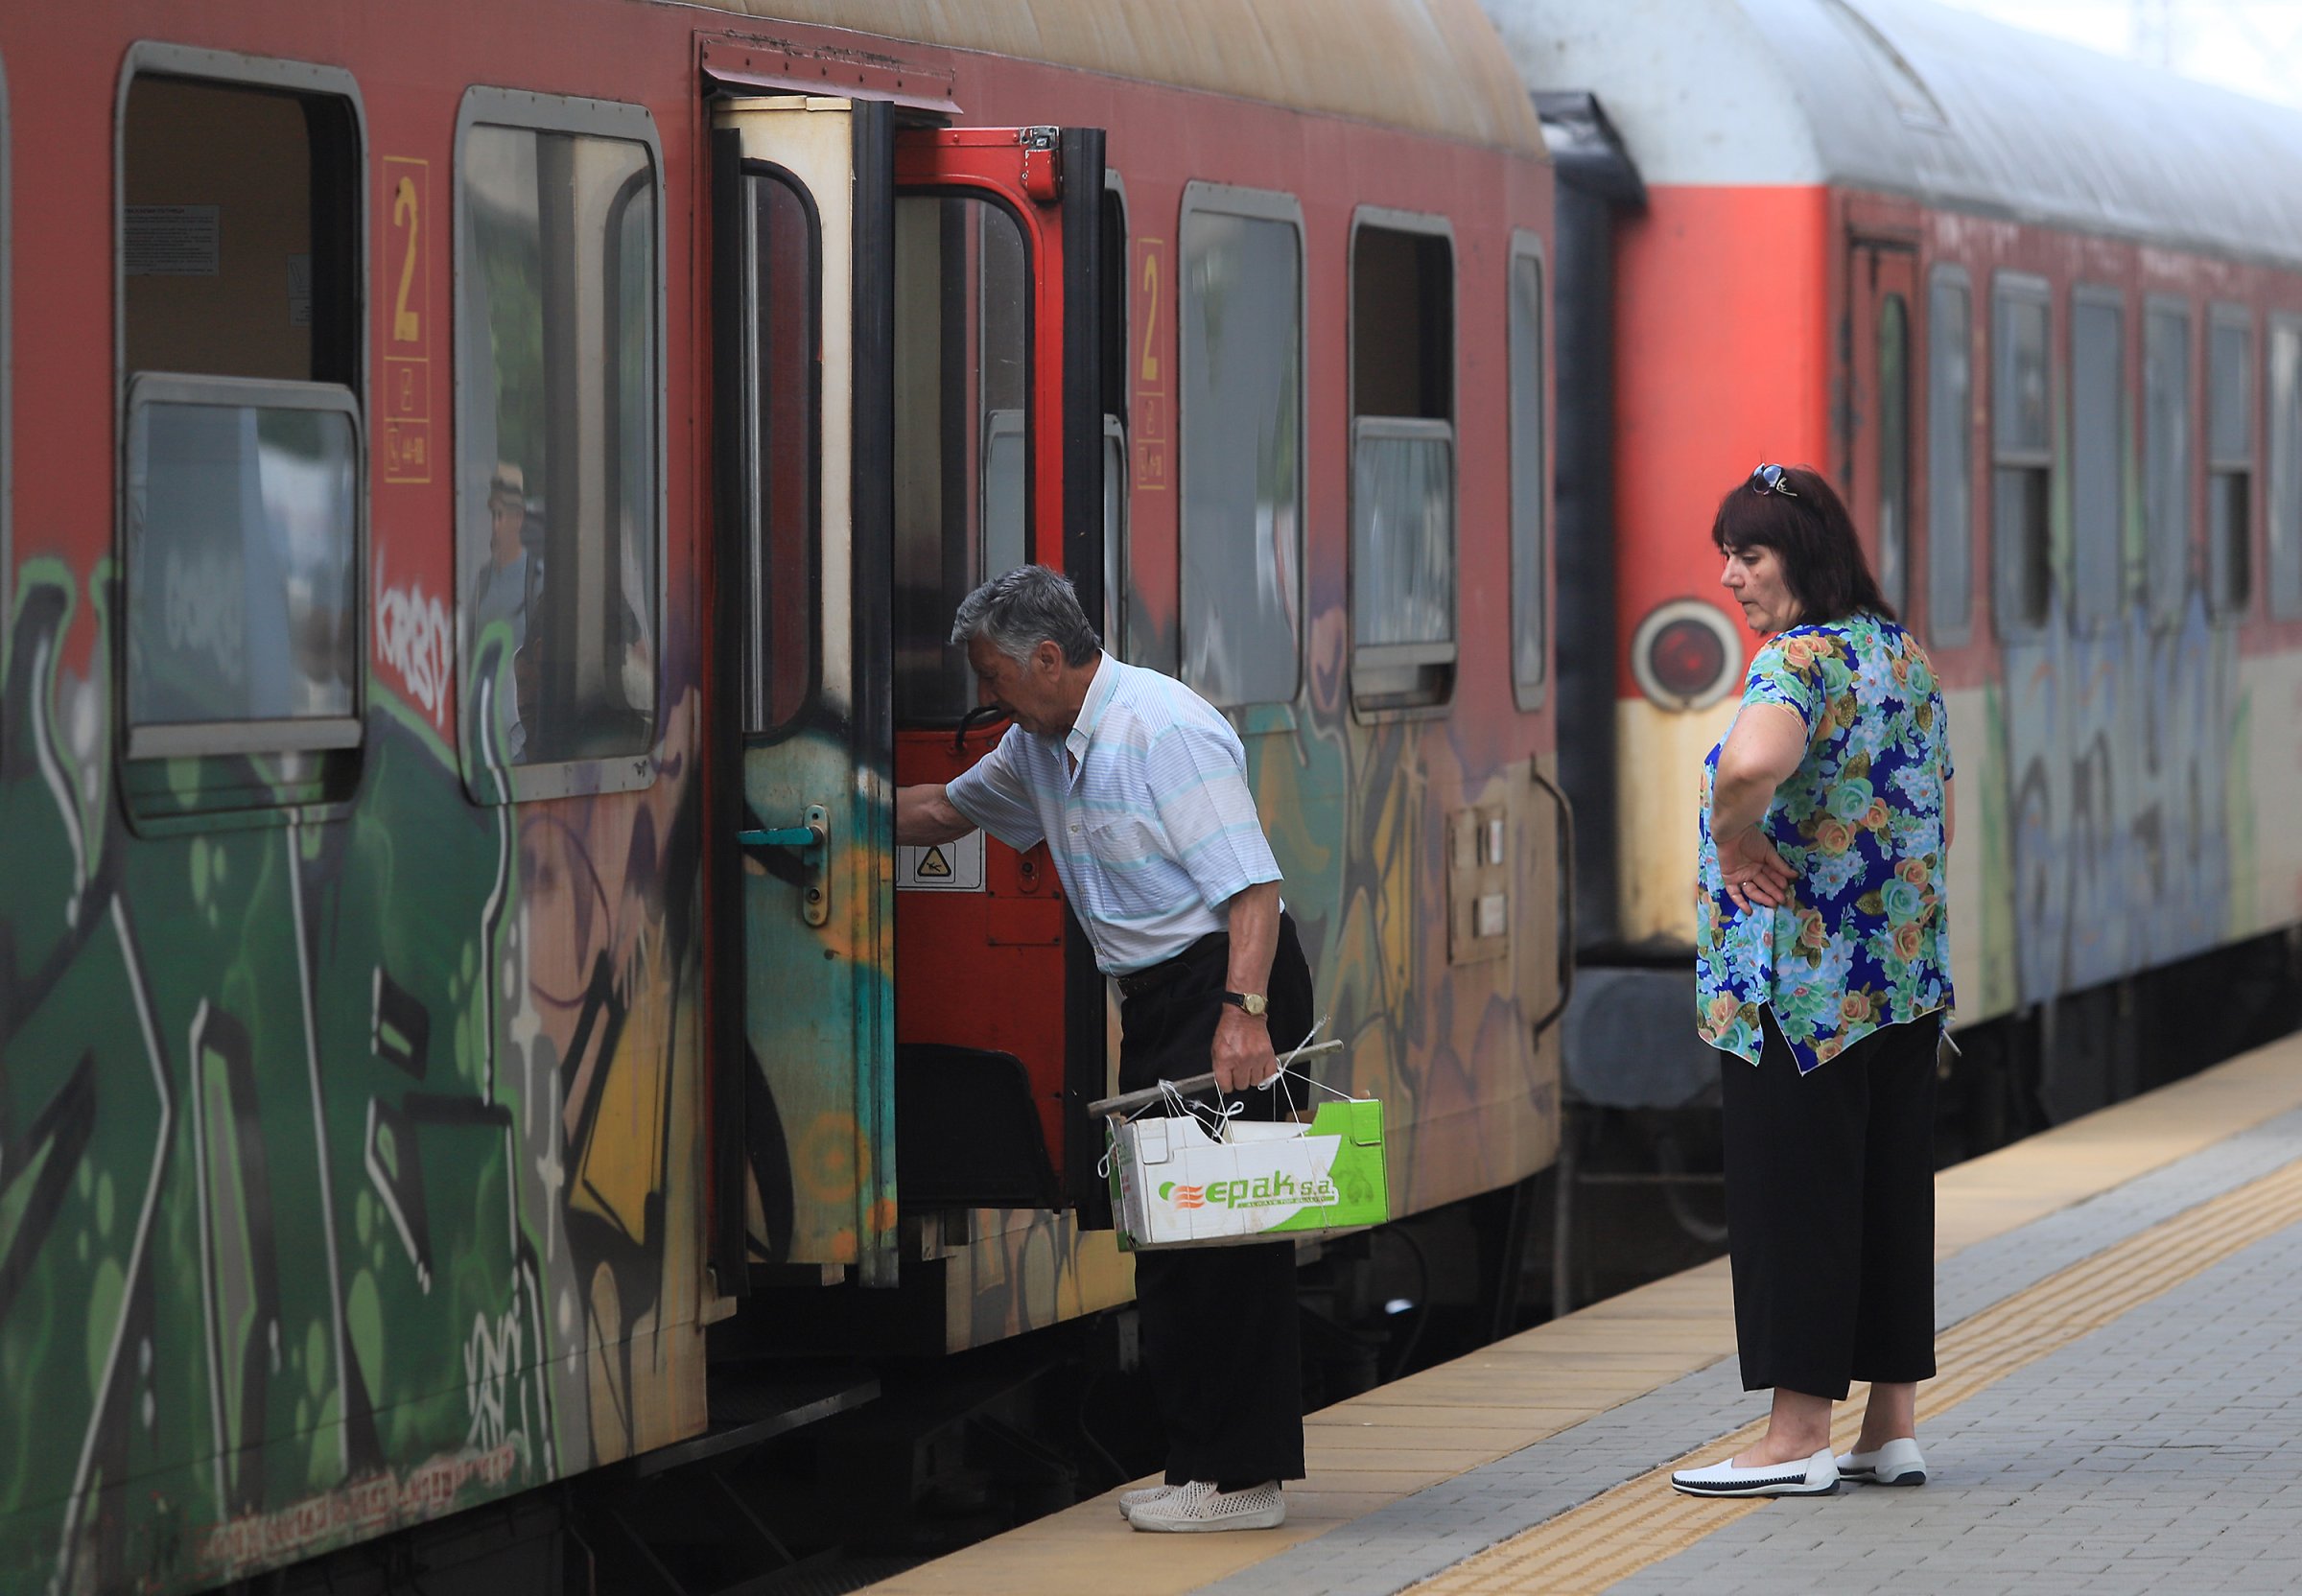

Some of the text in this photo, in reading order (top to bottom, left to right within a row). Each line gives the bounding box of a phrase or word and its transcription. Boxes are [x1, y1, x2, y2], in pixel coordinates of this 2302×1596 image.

[394, 176, 418, 341] 2
[1141, 254, 1158, 380] 2
[1206, 1170, 1334, 1209] epak s.a.
